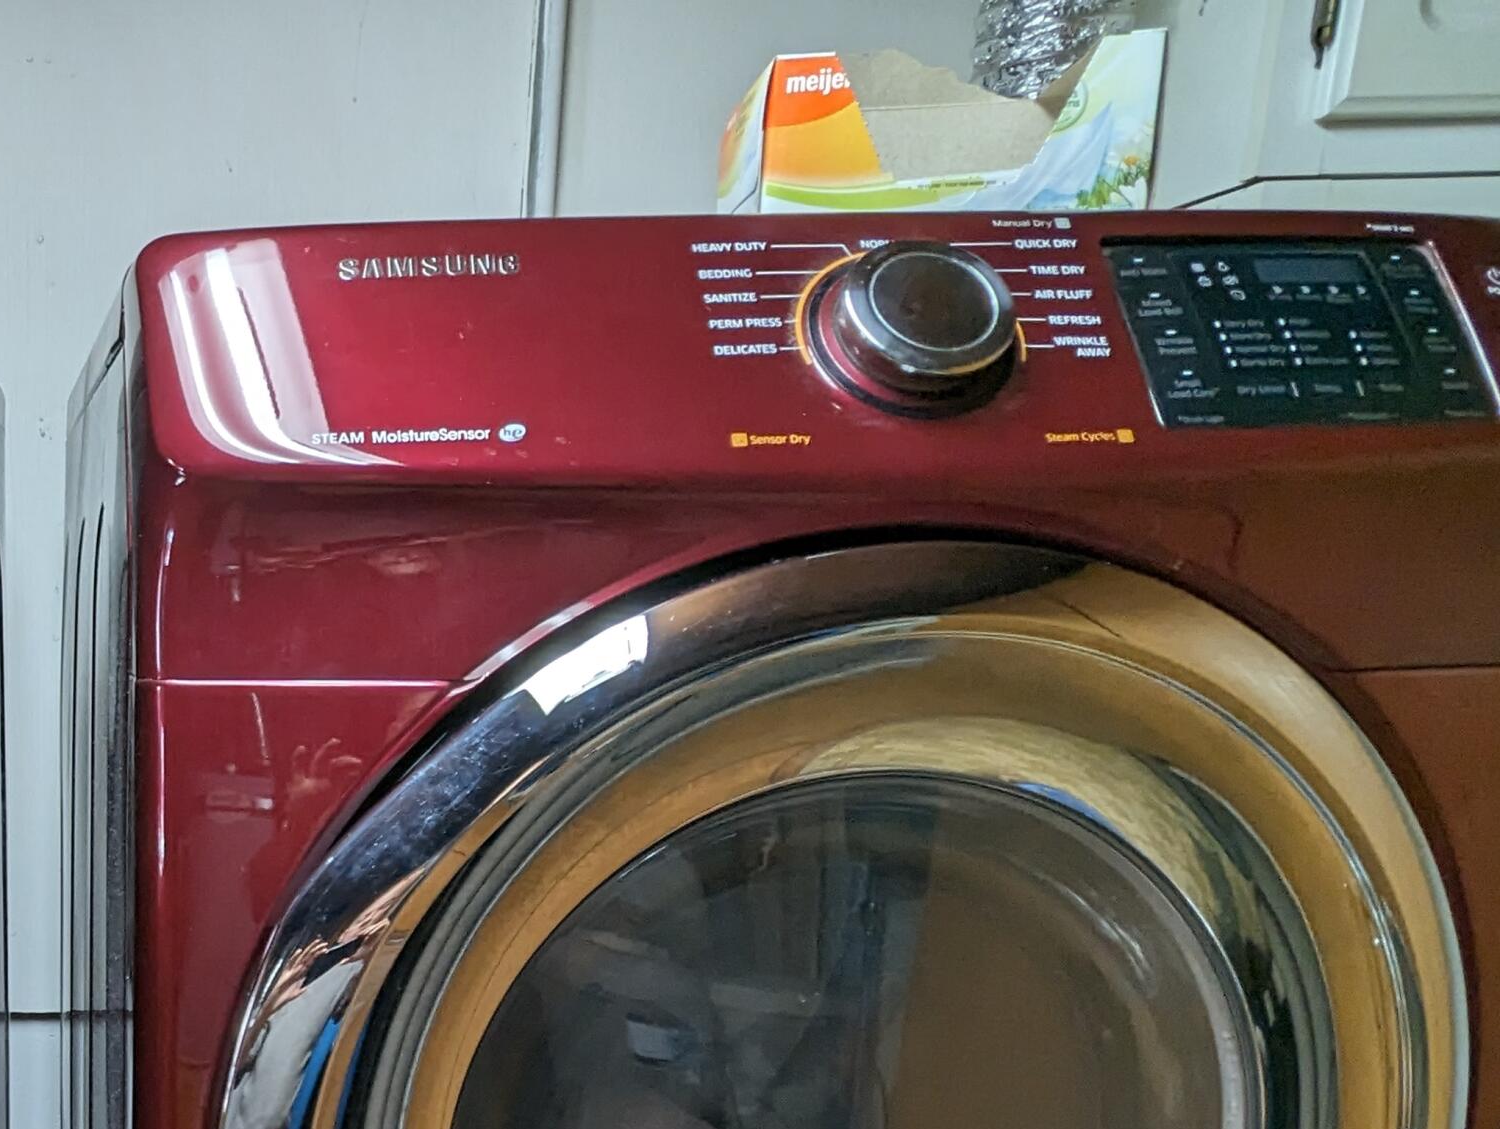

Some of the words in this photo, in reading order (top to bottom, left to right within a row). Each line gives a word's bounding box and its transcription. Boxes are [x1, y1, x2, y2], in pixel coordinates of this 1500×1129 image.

[991, 218, 1030, 228] Manual
[1032, 219, 1052, 229] Dry
[691, 243, 731, 253] HEAVY
[734, 241, 767, 252] DUTY
[1014, 238, 1051, 249] QUICK
[1053, 238, 1078, 249] DRY
[338, 254, 520, 280] SAMSUNG
[1029, 265, 1059, 275] TIME
[1061, 265, 1086, 275] DRY
[698, 268, 753, 280] BEDDING
[703, 292, 758, 304] SANITIZE
[1034, 289, 1055, 300] AIR
[1056, 289, 1093, 300] FLUFF
[708, 318, 744, 329] PERM
[745, 317, 783, 328] PRESS
[1048, 315, 1102, 325] REFRESH
[1052, 336, 1109, 347] WRINKLE
[713, 343, 777, 356] DELICATES
[1076, 348, 1112, 357] AWAY
[311, 431, 365, 444] STEAM
[371, 427, 491, 444] MoistureSensor
[749, 435, 787, 446] Sensor
[788, 433, 811, 447] Dry
[1044, 432, 1079, 443] Steam
[1080, 431, 1116, 444] Cycles
